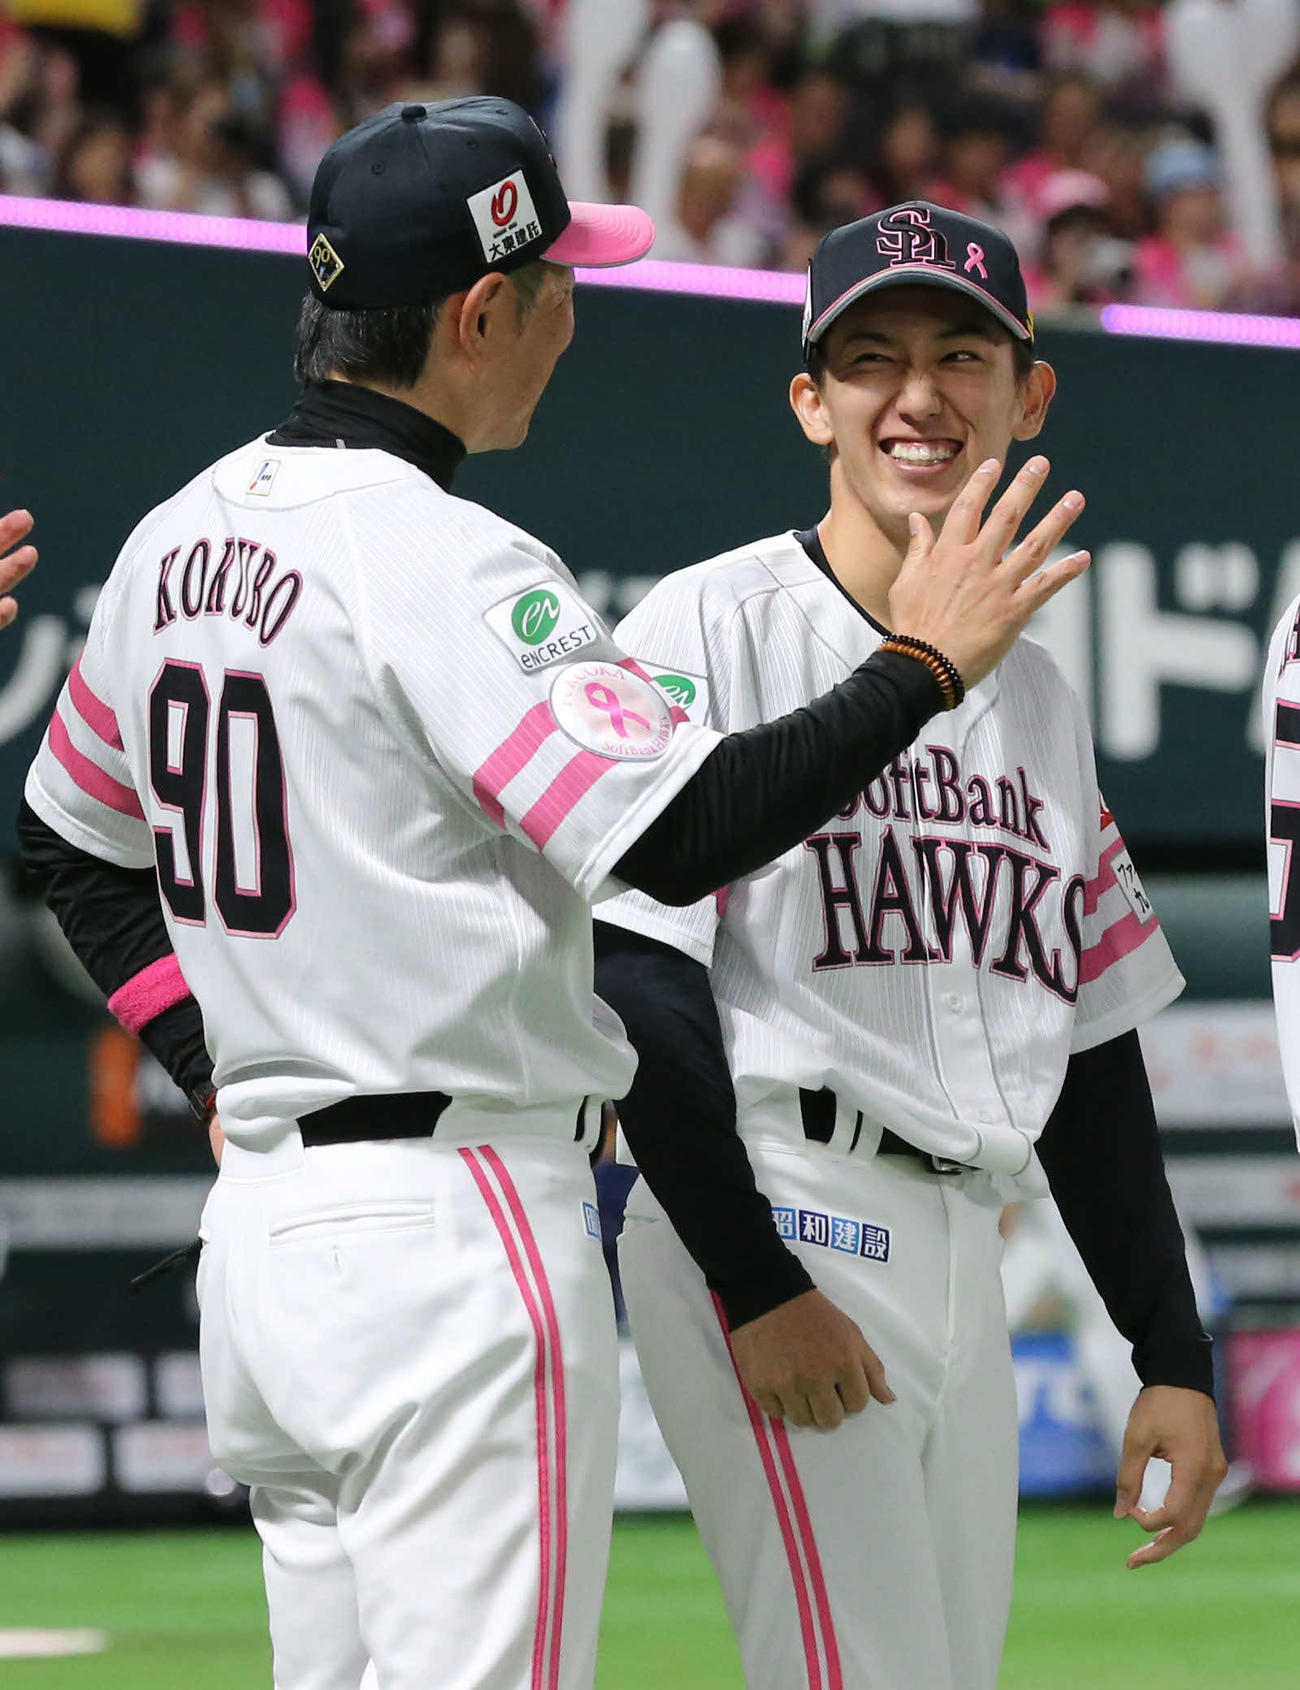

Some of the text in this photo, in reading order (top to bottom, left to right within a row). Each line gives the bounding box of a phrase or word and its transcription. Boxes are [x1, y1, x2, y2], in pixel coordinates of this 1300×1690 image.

[314, 246, 330, 268] 90
[488, 220, 541, 261] 大東建託
[153, 537, 304, 648] KOKUBO
[148, 656, 298, 940] 90
[836, 743, 1051, 853] oftBank
[802, 823, 1081, 1007] HAWKS
